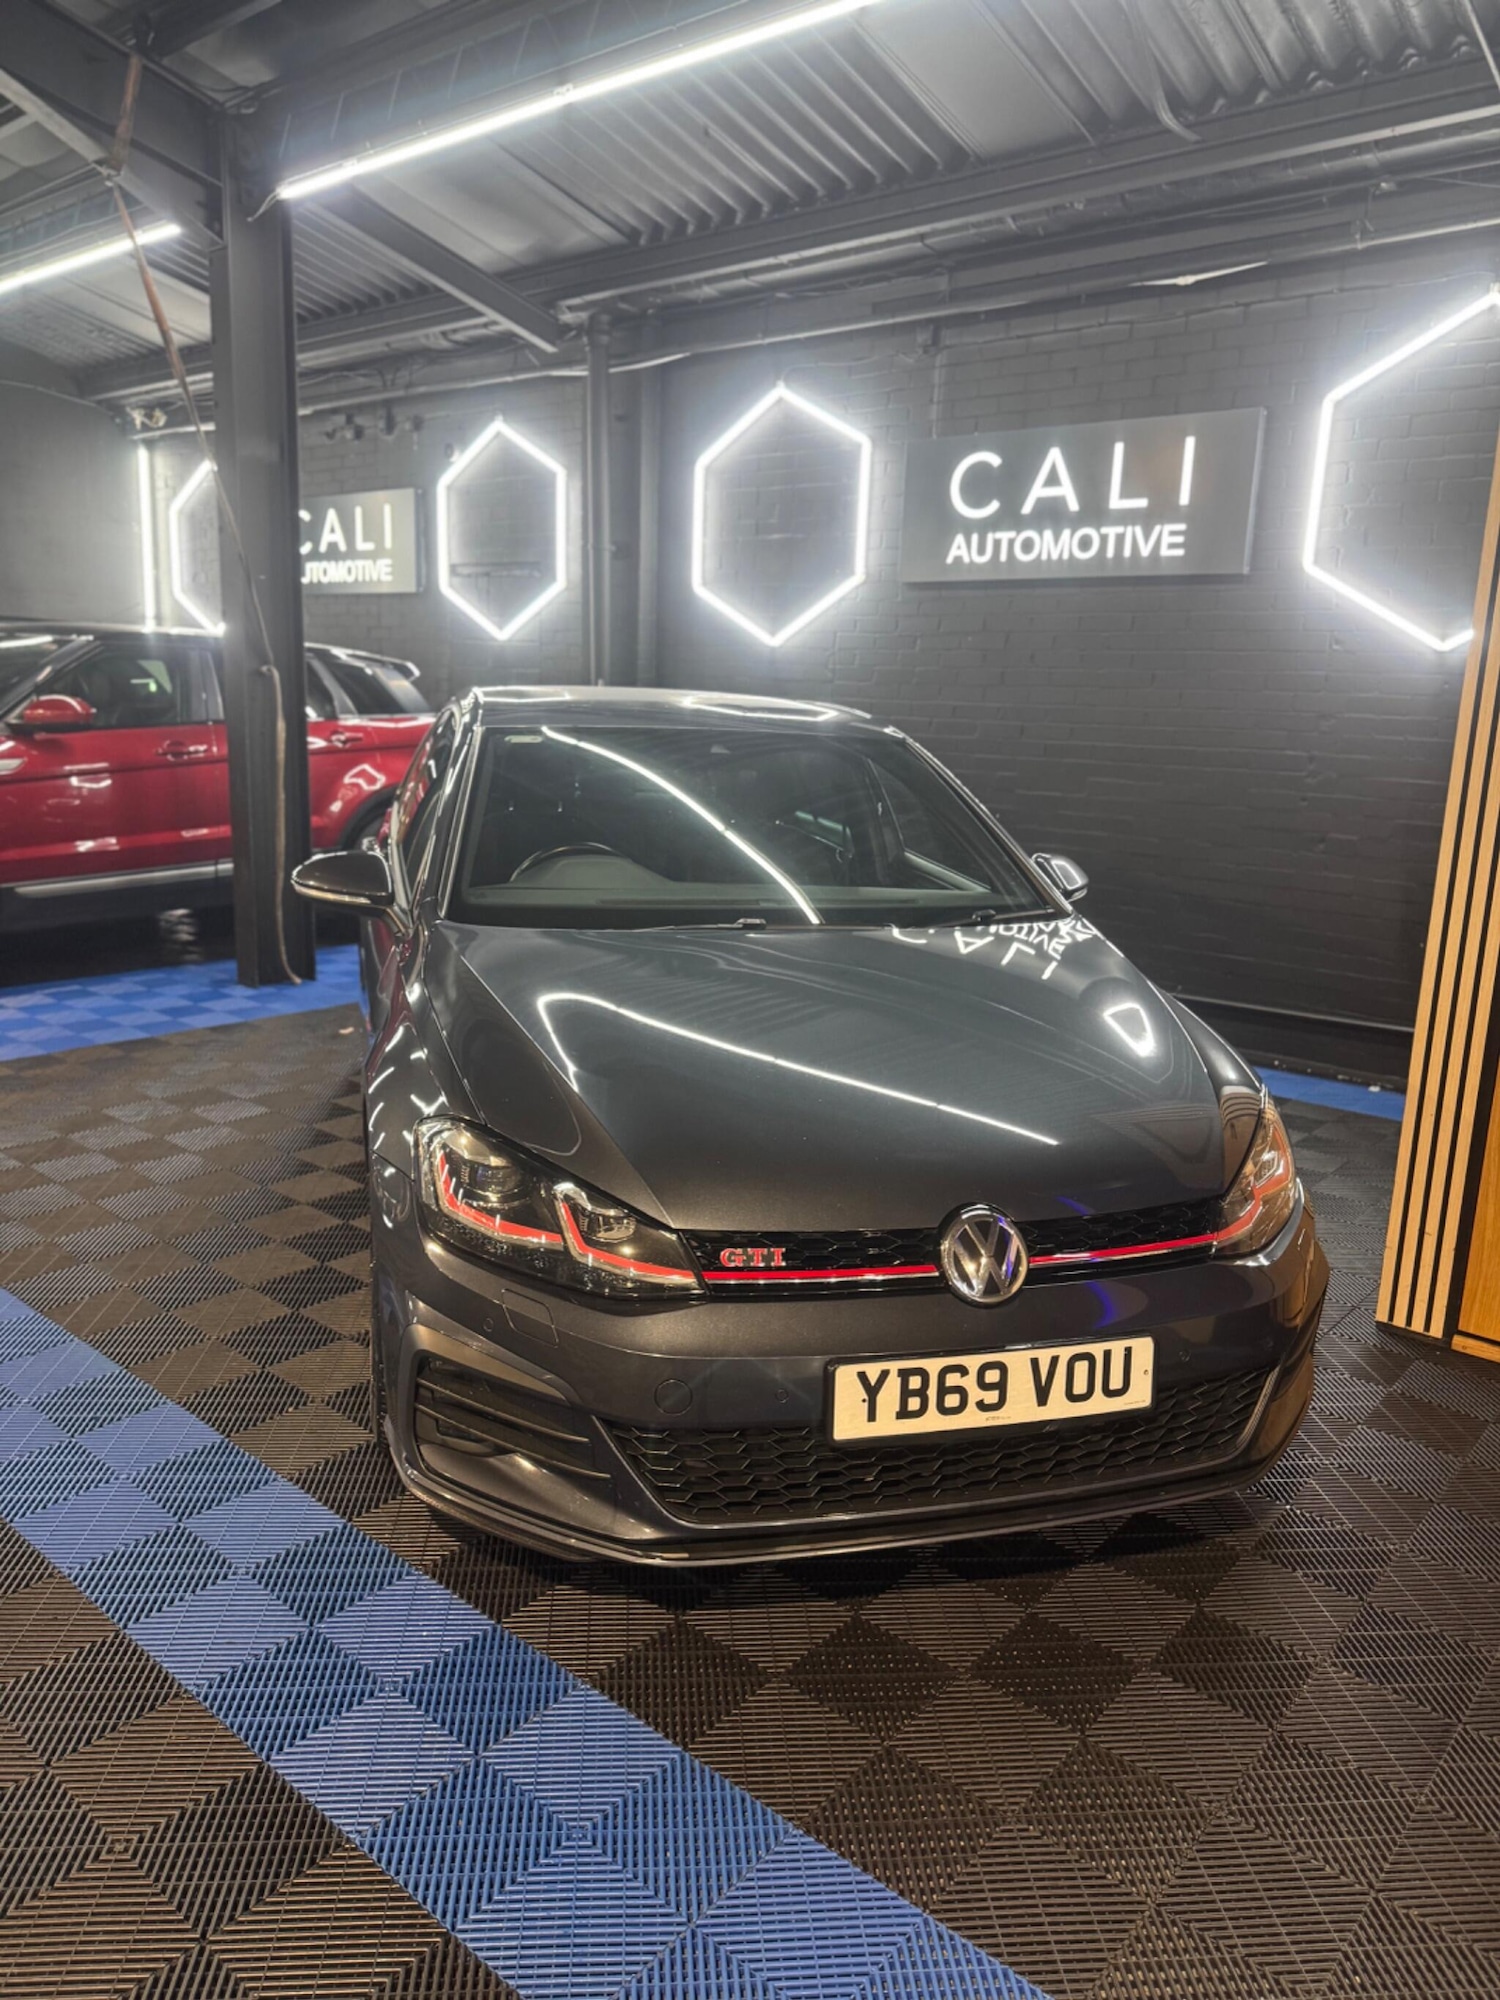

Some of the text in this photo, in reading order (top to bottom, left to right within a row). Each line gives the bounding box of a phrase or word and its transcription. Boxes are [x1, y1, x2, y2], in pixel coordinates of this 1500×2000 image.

[949, 435, 1196, 519] CALI
[945, 523, 1187, 564] AUTOMOTIVE
[300, 558, 393, 584] UTOMOTIVE
[719, 1248, 786, 1267] GTI
[856, 1346, 1133, 1422] YB69 VOU
